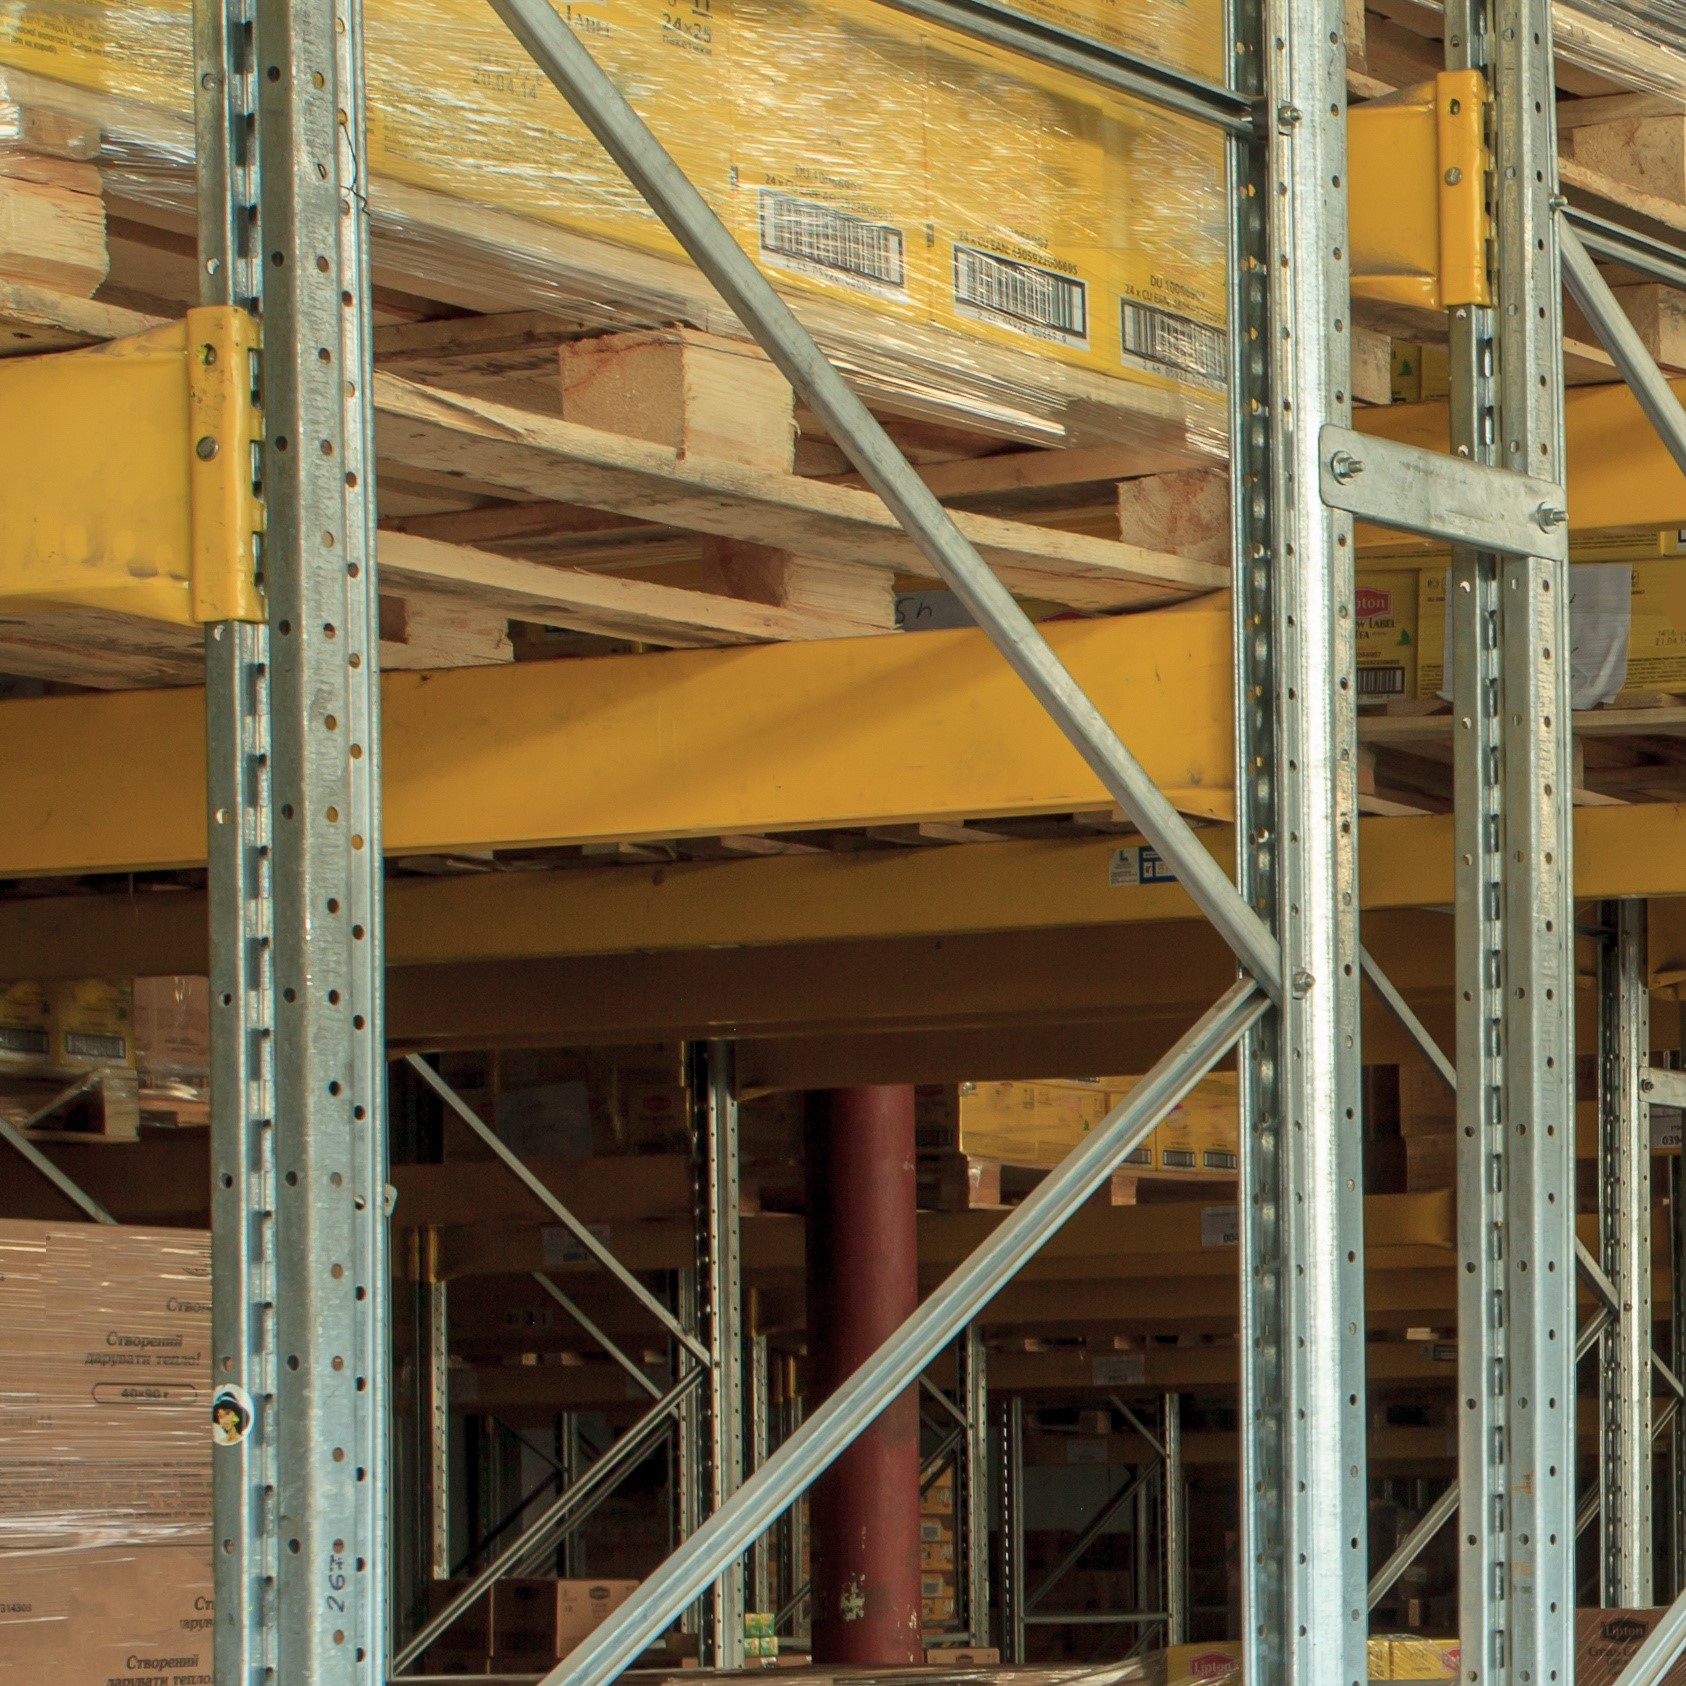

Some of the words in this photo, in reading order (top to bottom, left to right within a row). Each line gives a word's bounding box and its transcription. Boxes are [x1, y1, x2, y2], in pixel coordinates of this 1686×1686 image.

[106, 1331, 183, 1350] Створений
[84, 1352, 152, 1368] дарувати
[1603, 1623, 1644, 1639] Lipton
[126, 1654, 199, 1672] Створений
[1193, 1658, 1232, 1677] Lipton
